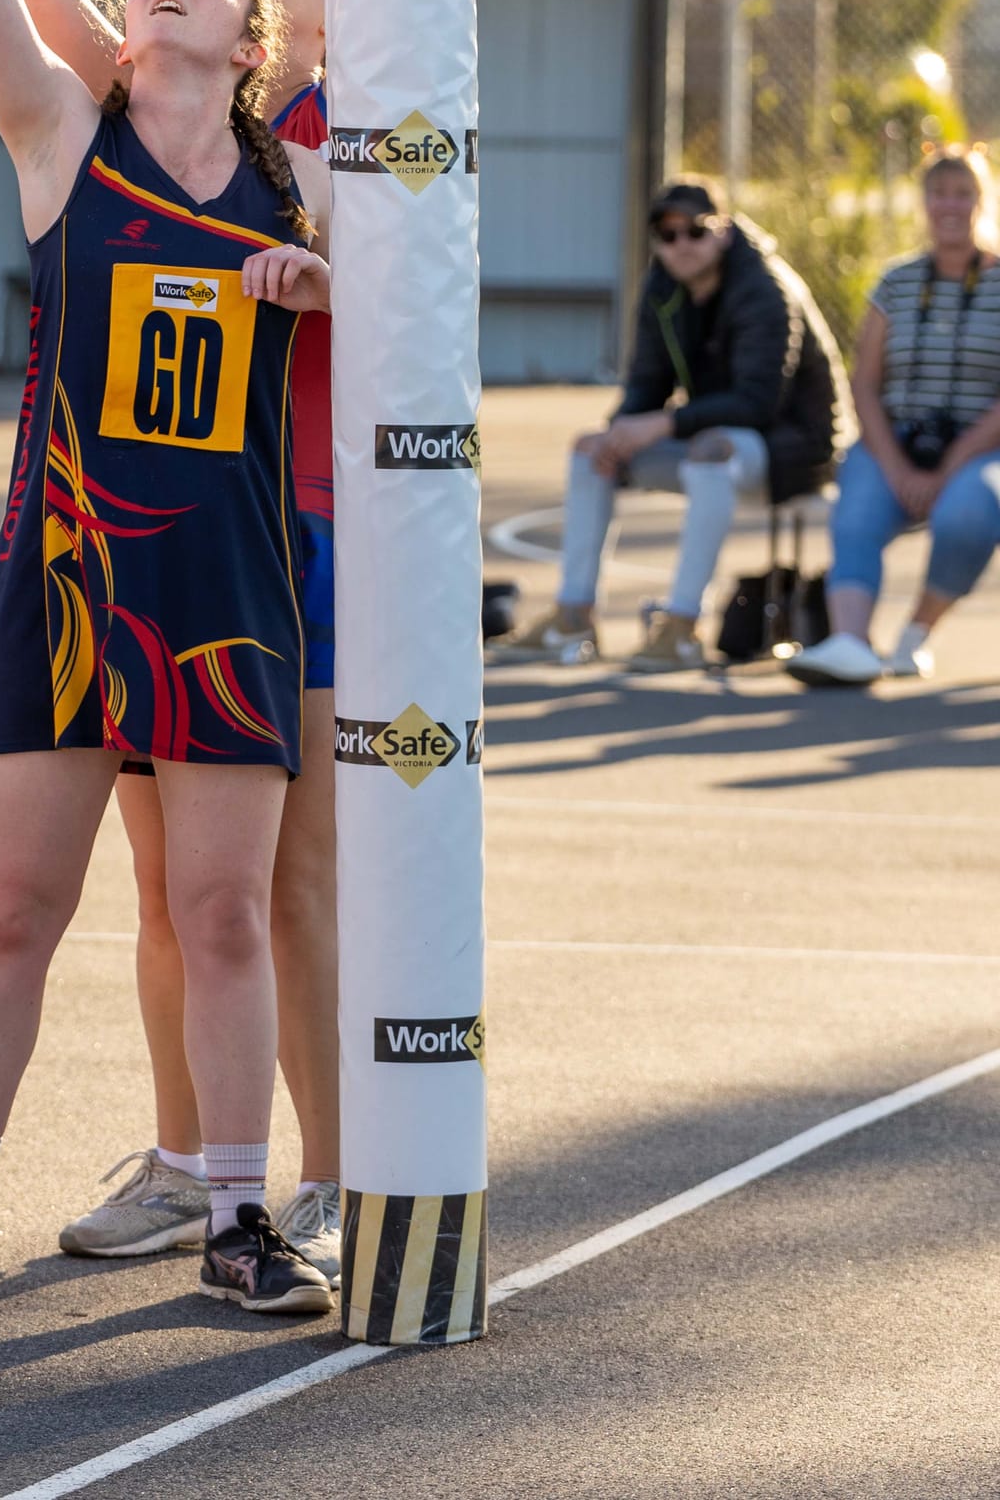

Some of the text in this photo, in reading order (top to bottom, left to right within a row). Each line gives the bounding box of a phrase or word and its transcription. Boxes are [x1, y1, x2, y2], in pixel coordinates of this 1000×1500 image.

[133, 310, 224, 441] GD
[335, 725, 447, 756] orkSafe
[386, 1022, 484, 1052] WorkS
